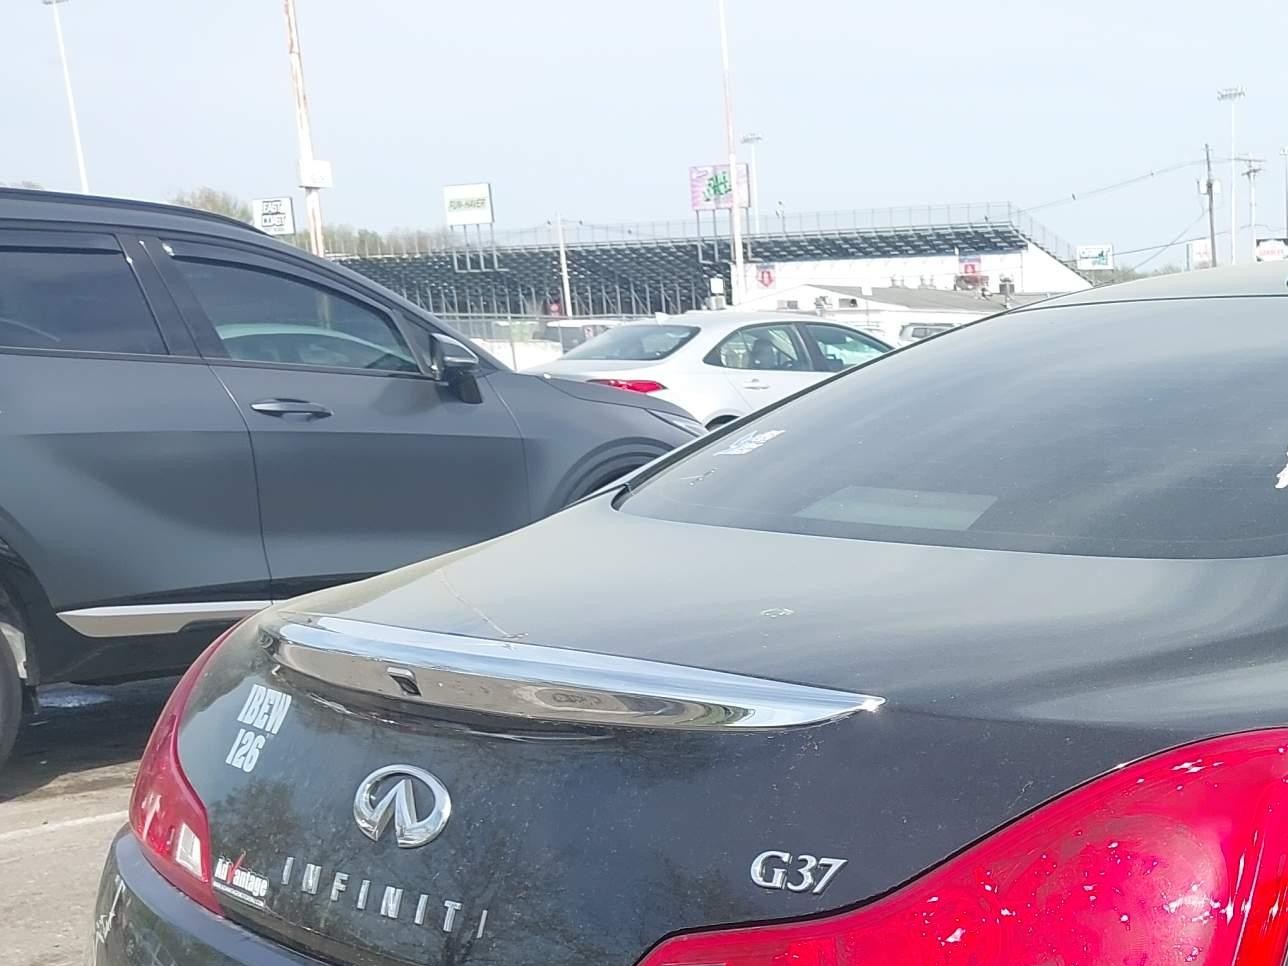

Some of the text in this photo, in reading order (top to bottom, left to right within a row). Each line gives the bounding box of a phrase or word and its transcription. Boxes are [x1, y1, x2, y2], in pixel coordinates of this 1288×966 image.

[237, 684, 292, 735] IBEW
[225, 728, 266, 773] 126
[750, 850, 848, 894] G37
[280, 856, 488, 939] INFINITI
